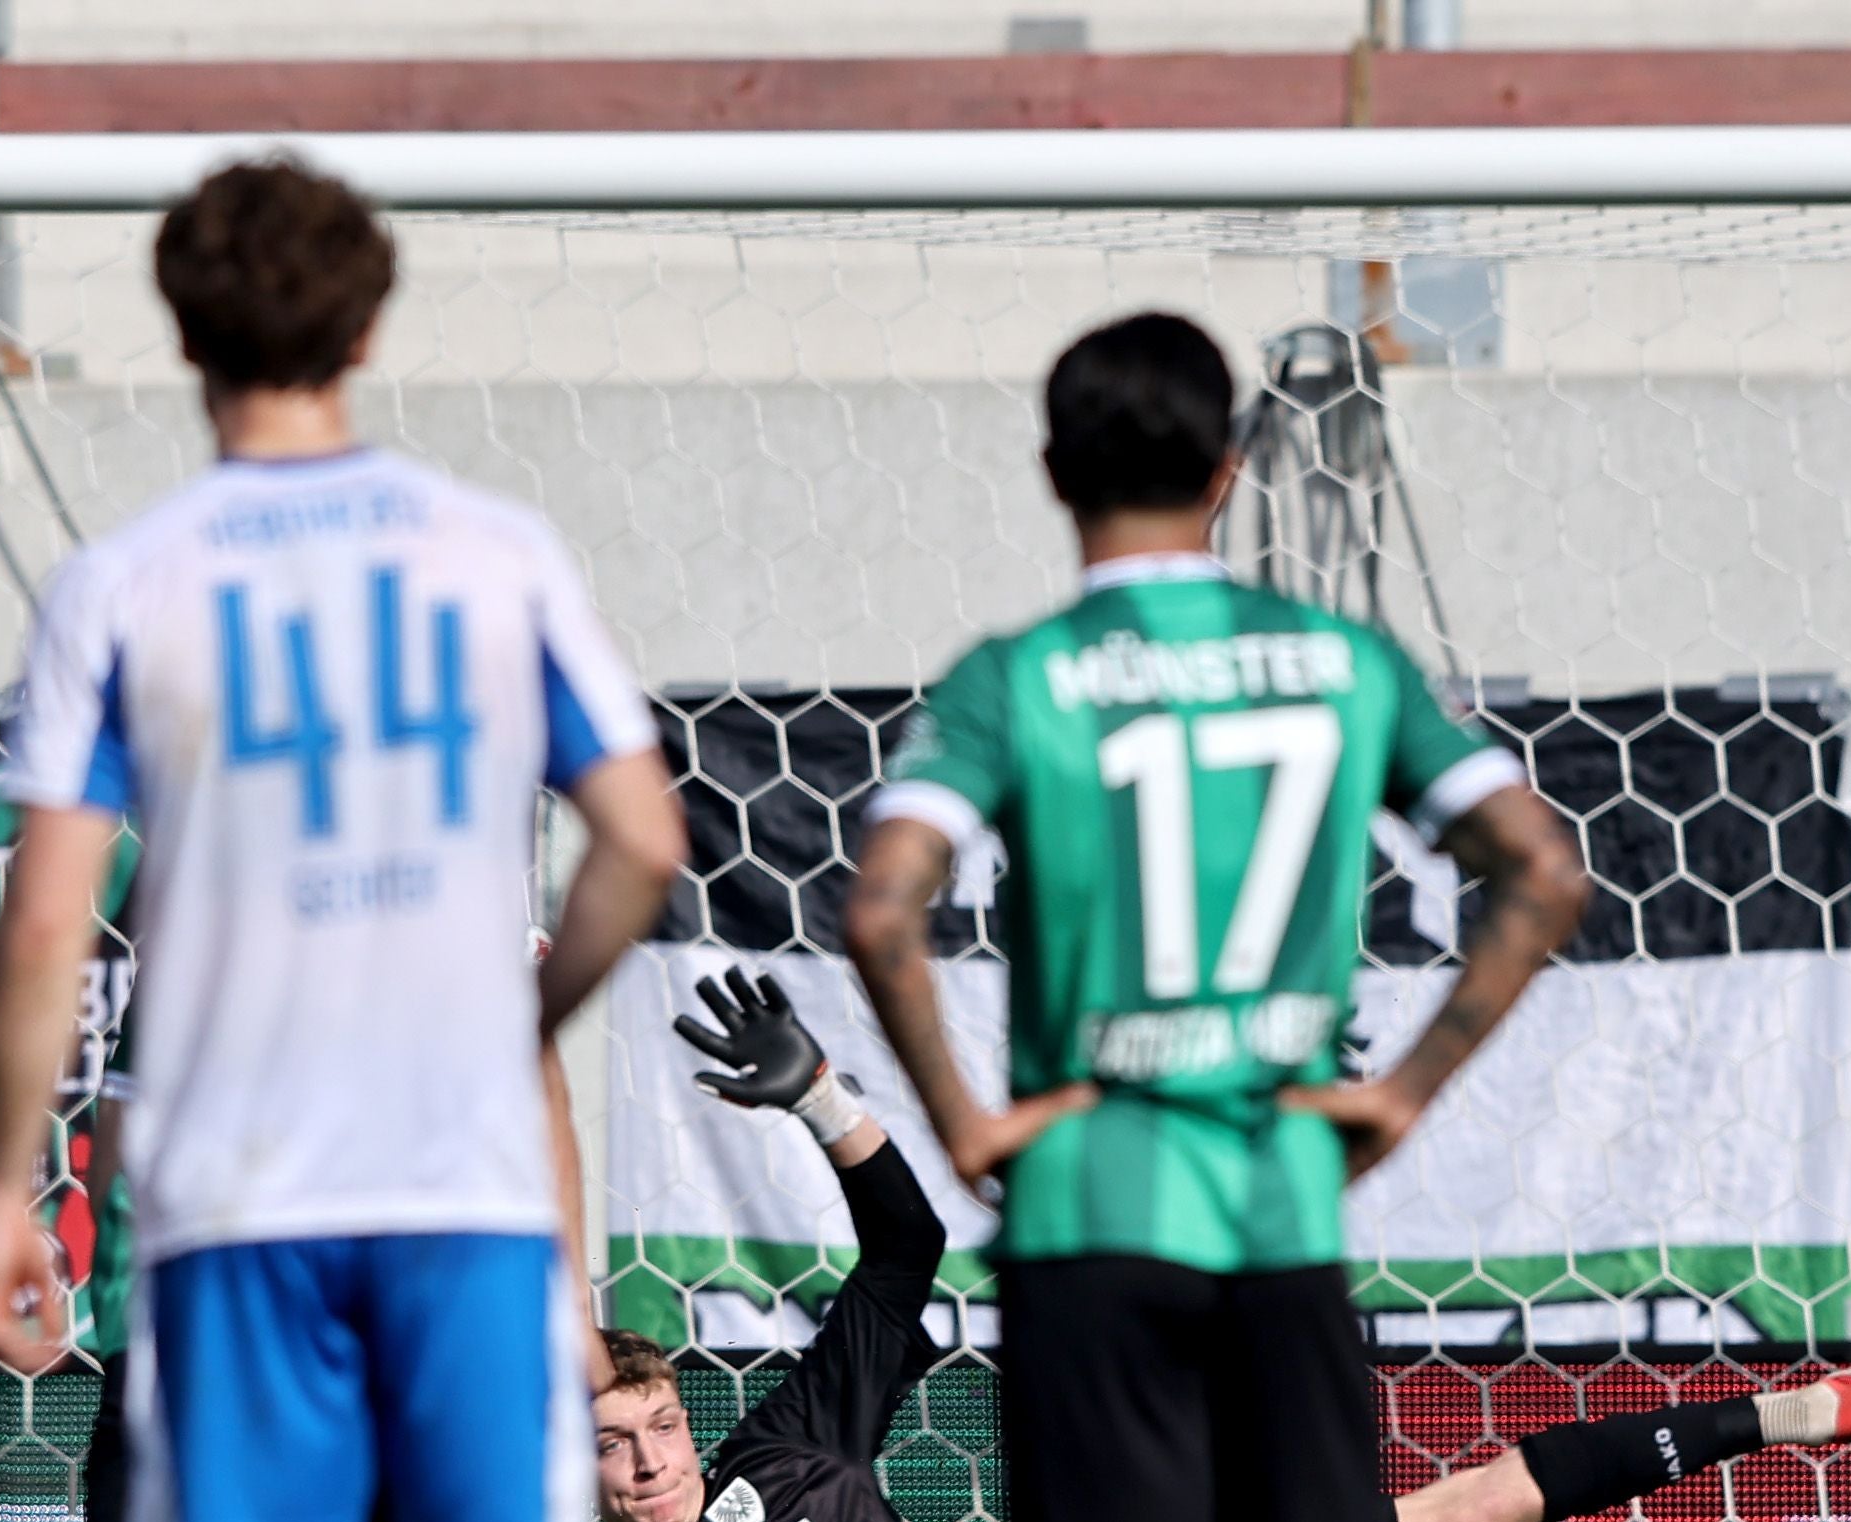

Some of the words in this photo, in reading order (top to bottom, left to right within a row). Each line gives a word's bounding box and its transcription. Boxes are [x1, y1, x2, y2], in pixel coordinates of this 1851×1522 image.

[214, 566, 478, 838] 44
[1044, 630, 1354, 714] MÜNSTER
[1098, 704, 1344, 998] 17
